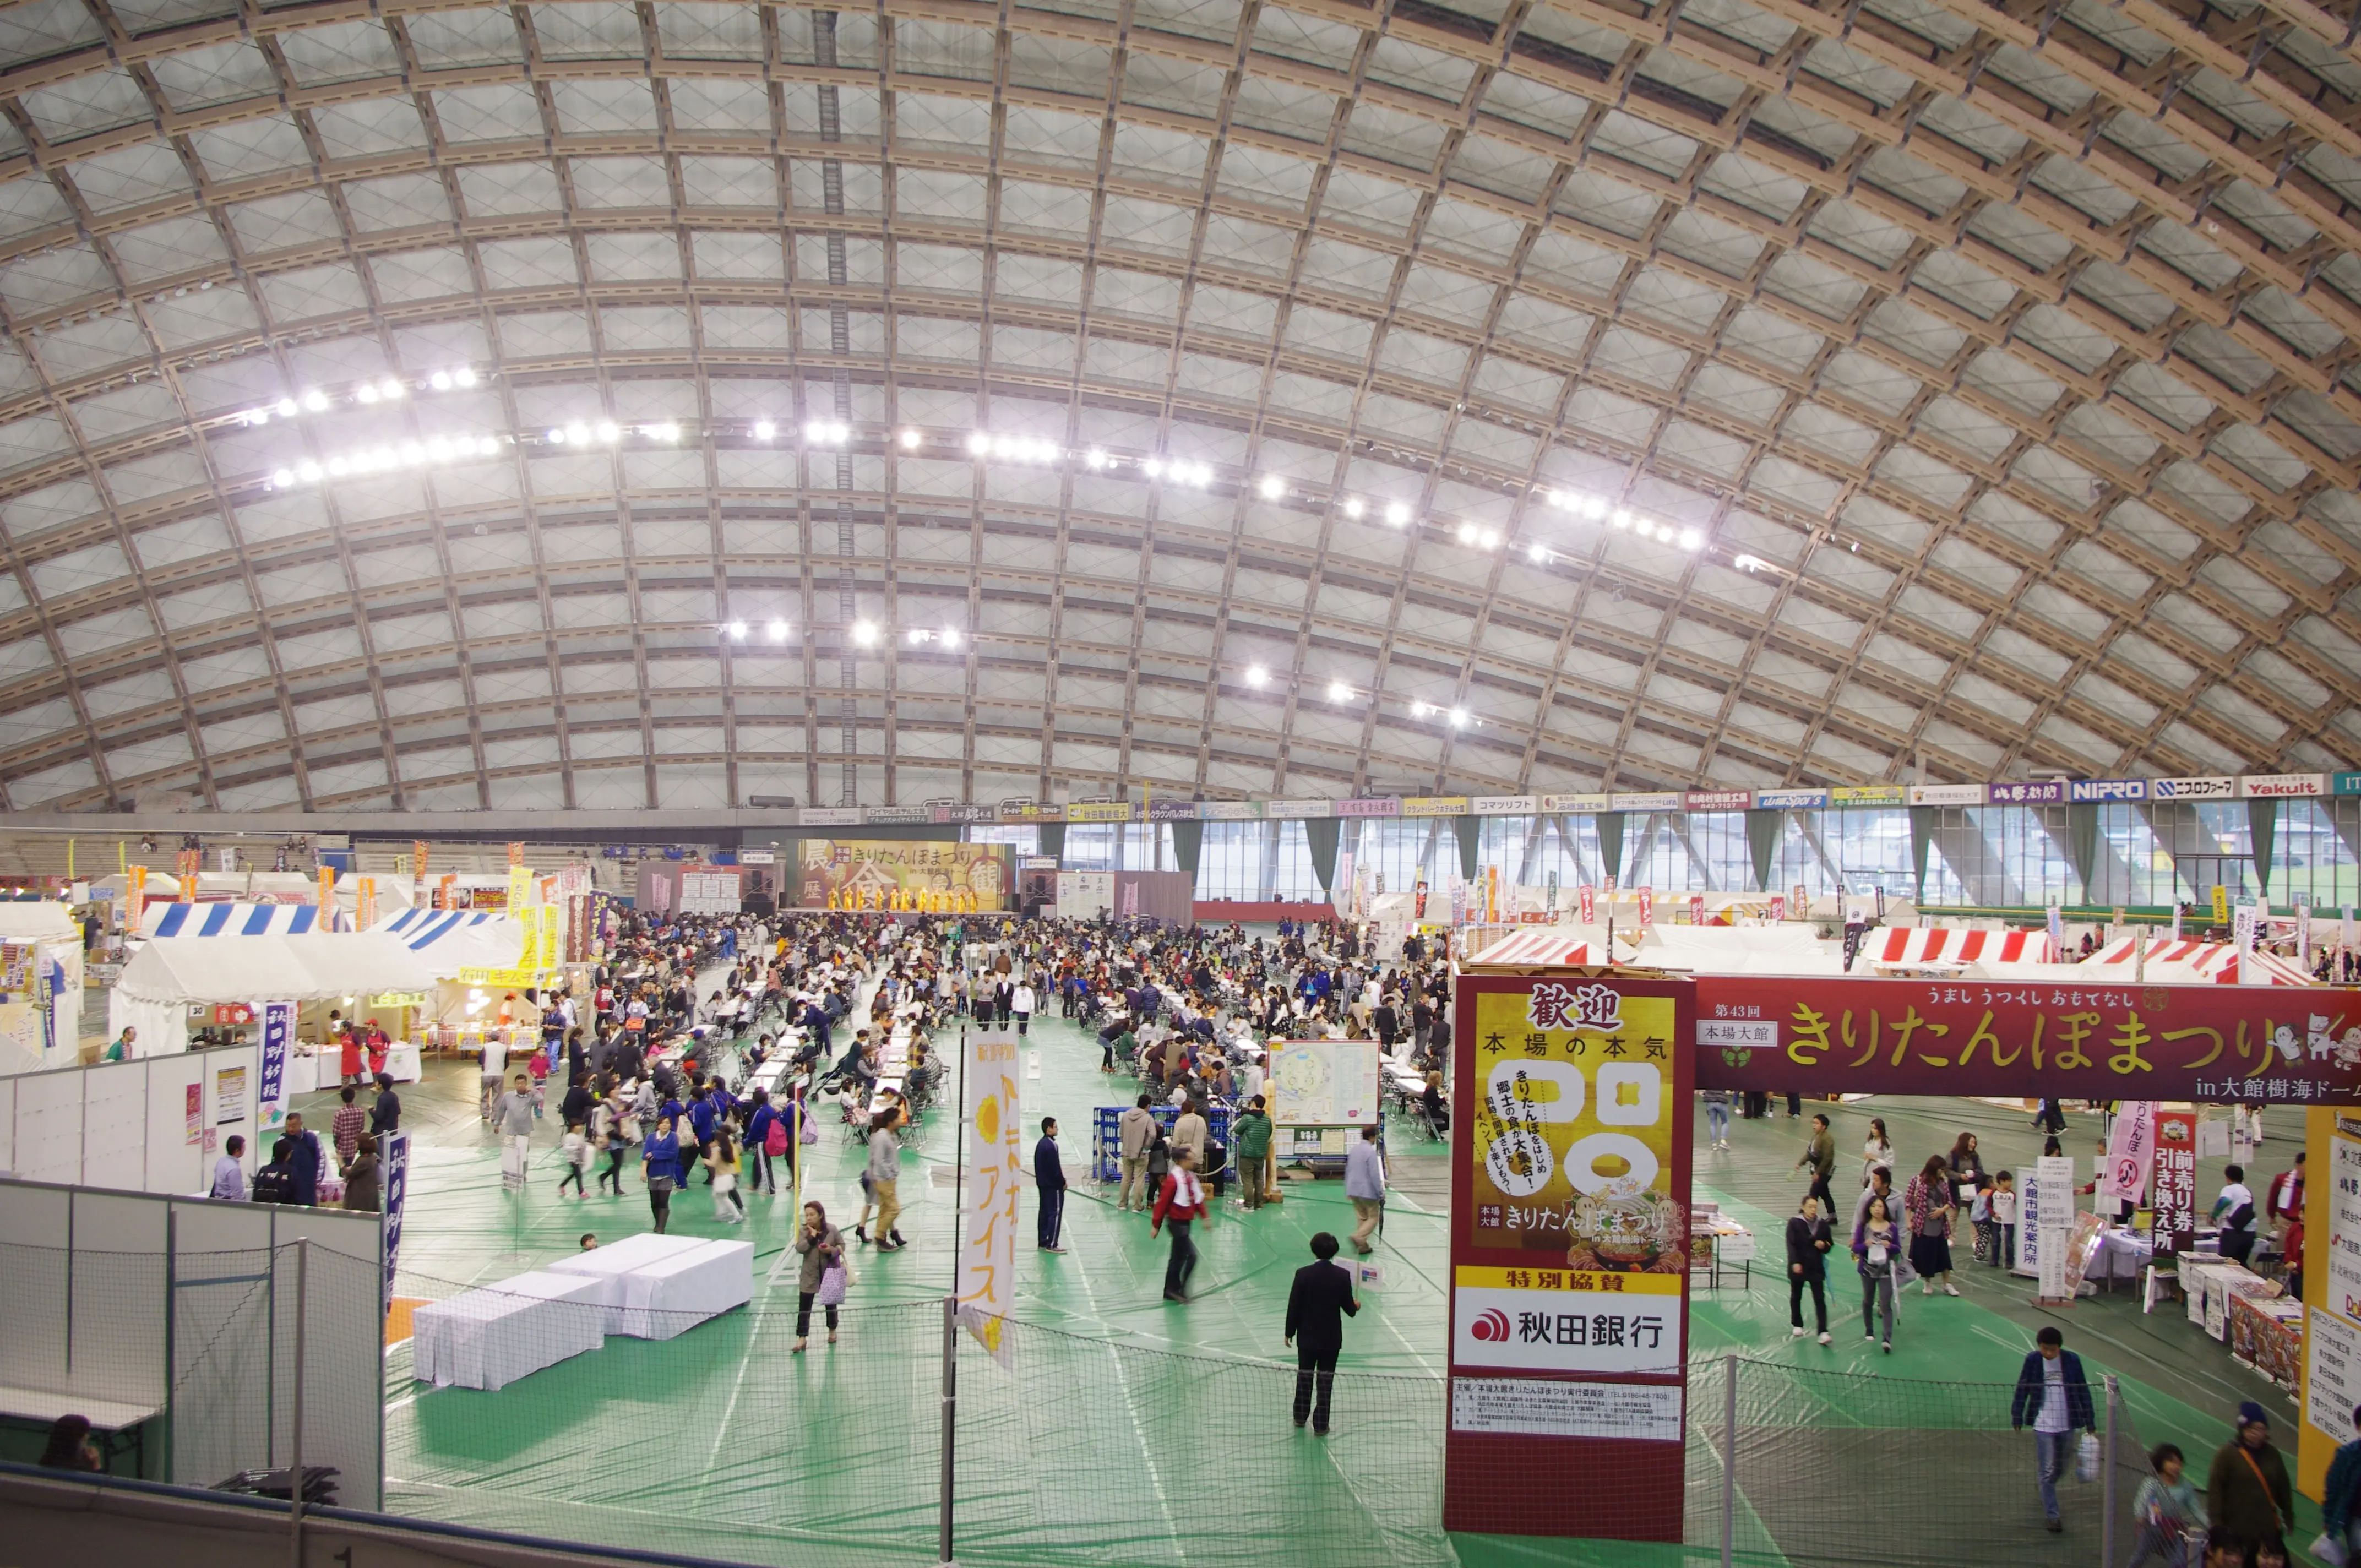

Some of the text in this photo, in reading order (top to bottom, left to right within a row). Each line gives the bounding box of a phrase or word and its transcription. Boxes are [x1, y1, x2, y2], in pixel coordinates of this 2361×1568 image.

[2074, 781, 2144, 799] NIPRO
[2176, 781, 2232, 794] ニプロファーマ
[2248, 782, 2318, 795] Yakult
[1479, 800, 1531, 809] コマツリフト
[854, 847, 971, 866] きりたんぽまつり
[1582, 894, 1592, 921] ラーメン
[1641, 895, 1651, 923] ラーメン
[1529, 984, 1622, 1030] 歓迎
[1927, 987, 2134, 1008] うまし うつくし おもてなし
[193, 1006, 203, 1015] 30
[1715, 1004, 1760, 1018] 第43回
[1705, 1025, 1770, 1041] 本場大館
[1787, 1002, 2275, 1077] きりたんぽまつり
[1483, 1032, 1667, 1060] 本場の本気
[2196, 1078, 2216, 1096] in
[1484, 1096, 1514, 1164] 同時に開催される
[1516, 1070, 1547, 1174] きりたんぽをはじめ
[2153, 1148, 2174, 1251] 引き換え所
[2174, 1150, 2194, 1232] 前売り券
[1481, 1206, 1500, 1216] 本場
[1481, 1216, 1500, 1227] 大館
[1506, 1204, 1666, 1232] きりたんぽまつり
[2024, 1177, 2038, 1265] 大館市観光案内所
[958, 1165, 1000, 1303] アイス
[1506, 1270, 1625, 1292] 特別協賛
[1518, 1311, 1663, 1348] 秋田銀行
